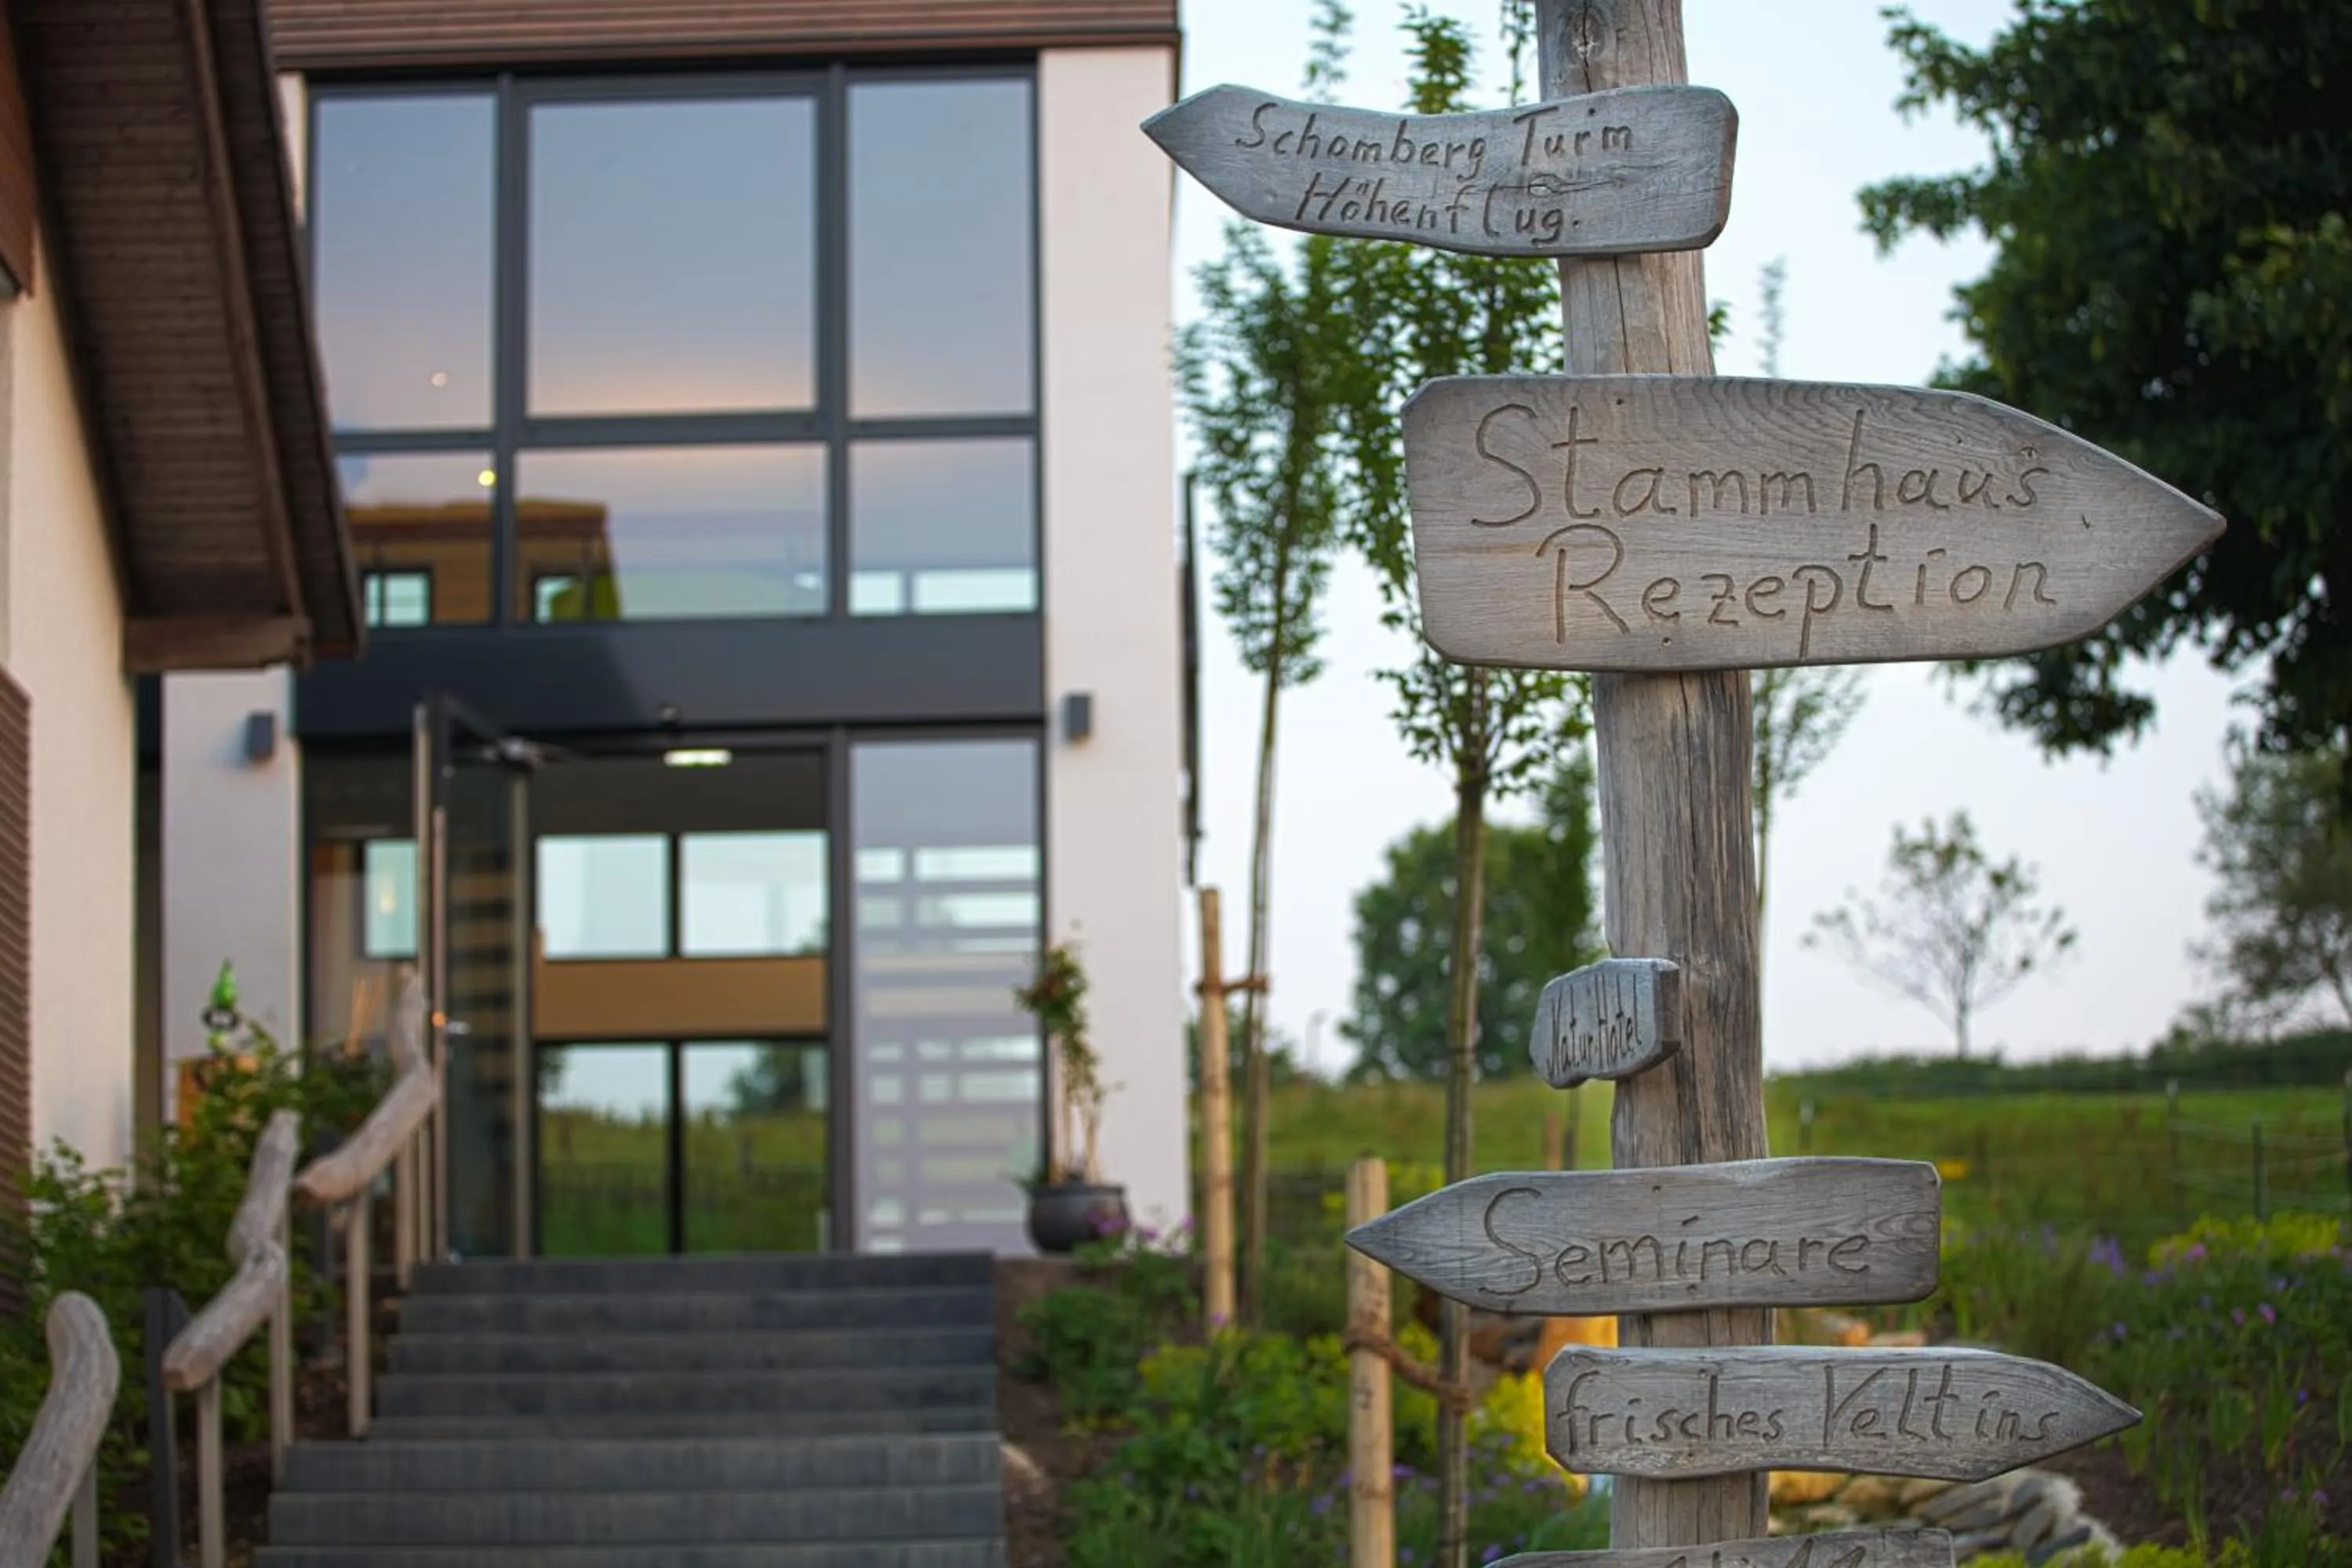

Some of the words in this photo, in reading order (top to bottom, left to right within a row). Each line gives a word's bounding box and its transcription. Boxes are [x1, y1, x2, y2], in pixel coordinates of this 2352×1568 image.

[1235, 101, 1486, 181] Schomberg
[1512, 105, 1633, 166] Turm
[1471, 403, 2050, 527] Stammhaus
[1536, 523, 2056, 659] Rezeption
[1478, 1186, 1871, 1295] Seminare
[1556, 1370, 1784, 1454] frisches
[1823, 1364, 2060, 1451] Veltins
